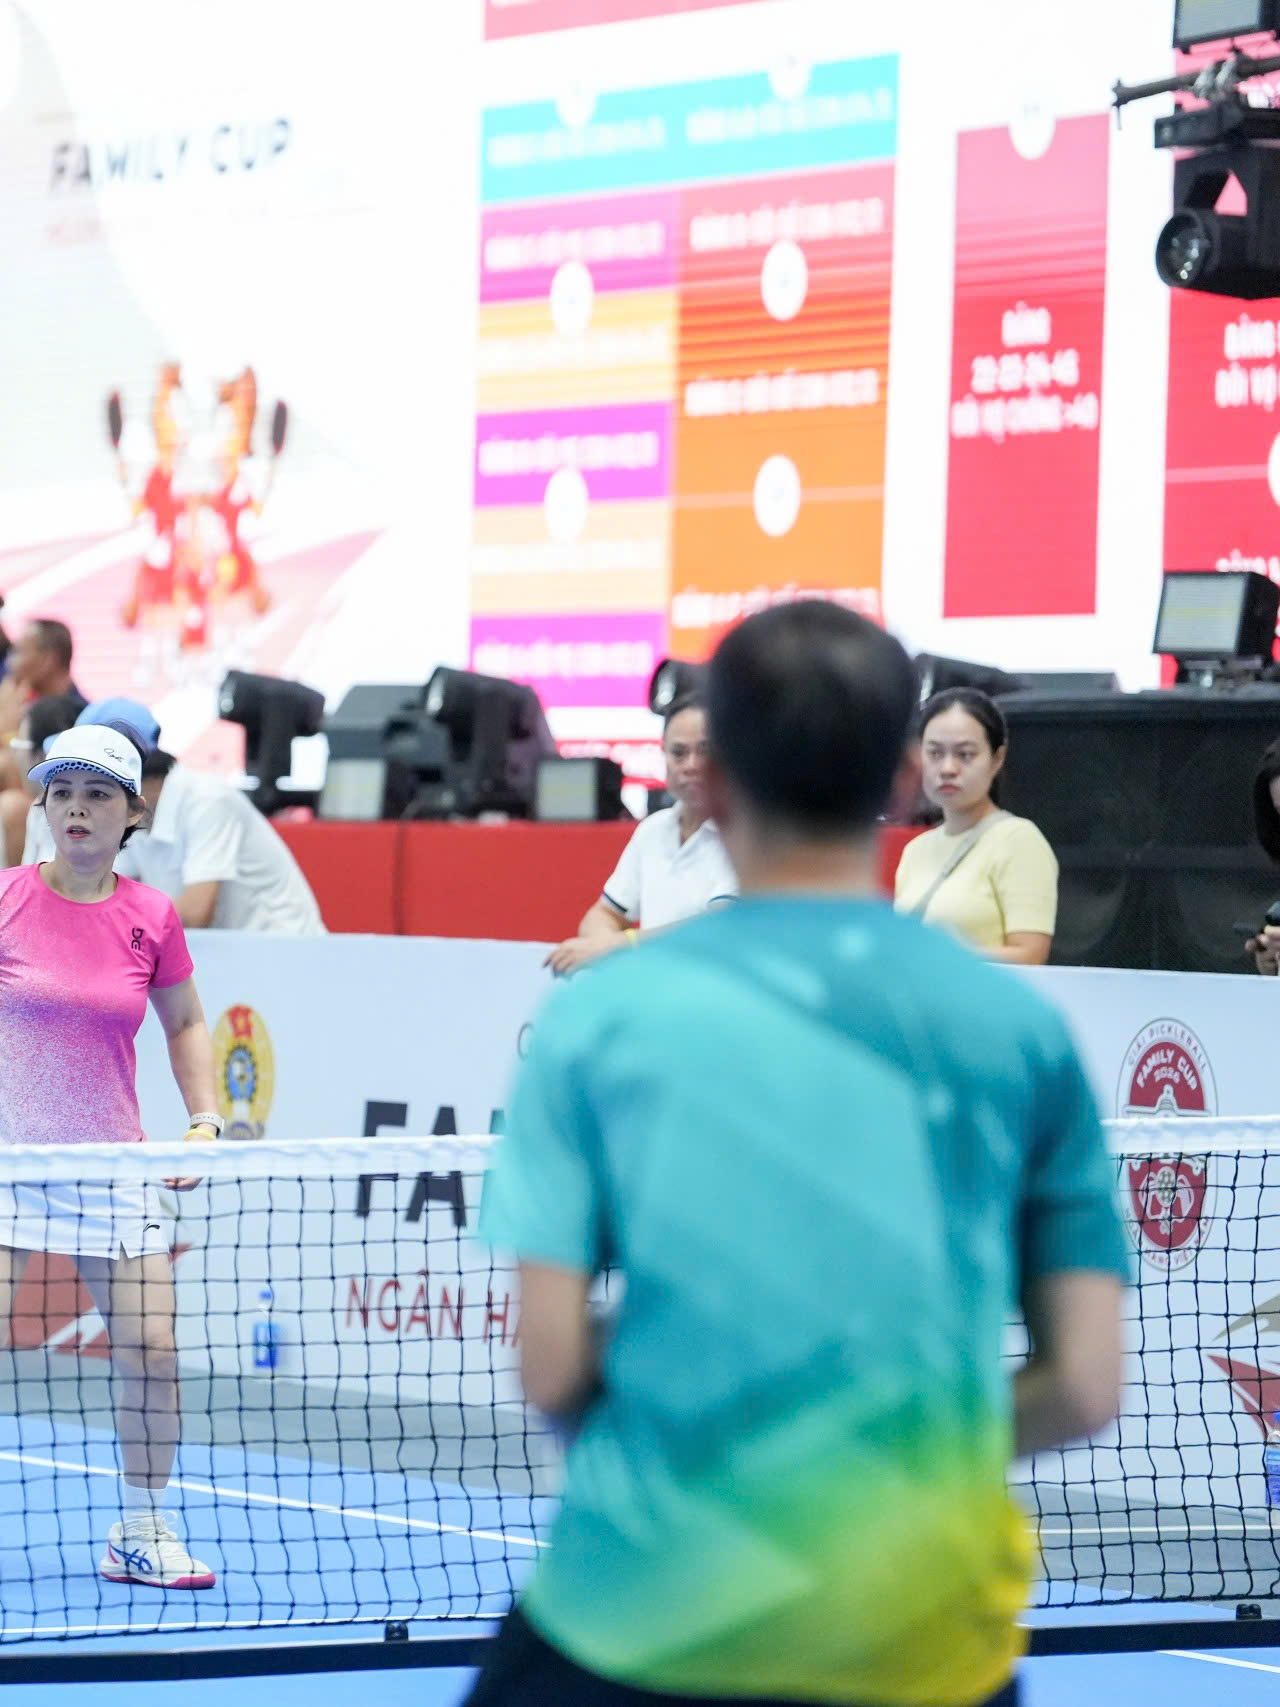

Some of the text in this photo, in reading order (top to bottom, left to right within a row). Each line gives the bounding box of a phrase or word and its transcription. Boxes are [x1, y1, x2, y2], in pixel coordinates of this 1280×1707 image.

[209, 117, 291, 176] CUP
[1136, 1048, 1198, 1091] FAMILY CUP
[345, 1267, 465, 1340] NGÂN
